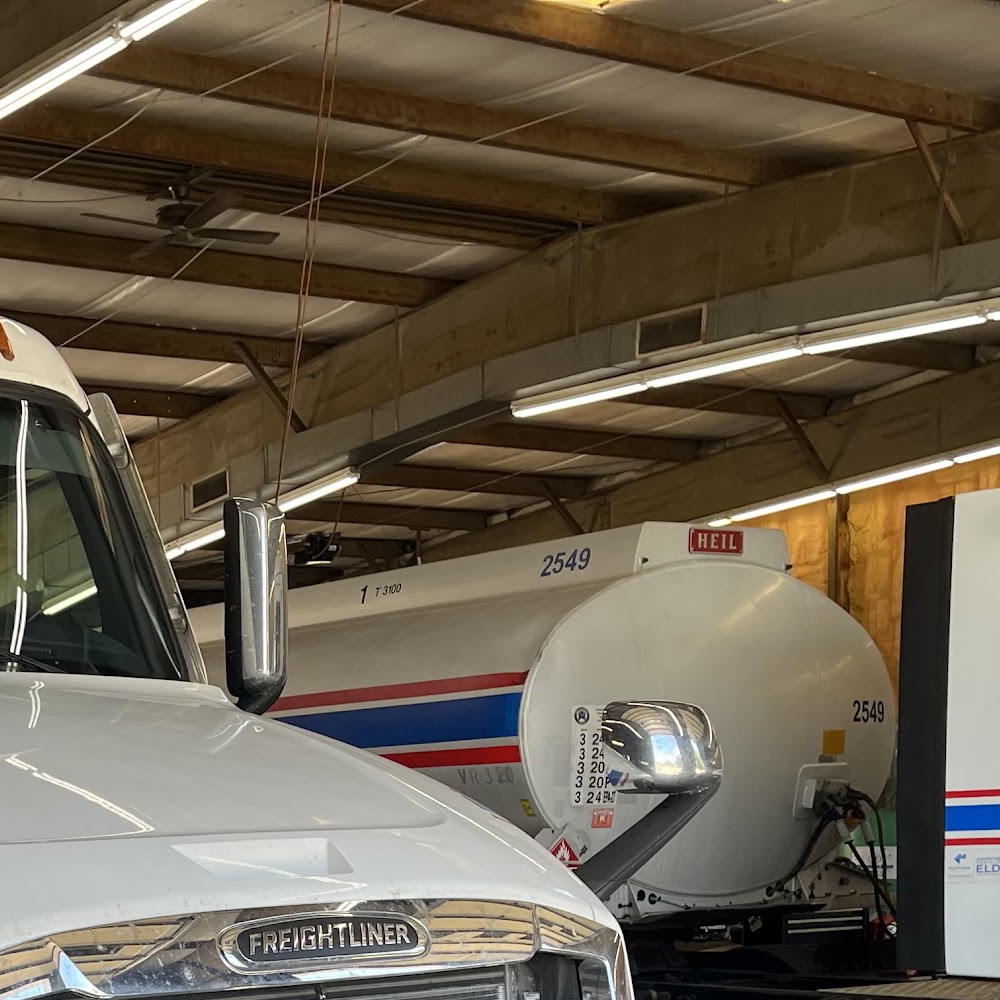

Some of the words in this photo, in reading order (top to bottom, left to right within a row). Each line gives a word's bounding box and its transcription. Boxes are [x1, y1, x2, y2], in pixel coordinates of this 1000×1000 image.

[697, 532, 737, 550] HEIL
[540, 547, 591, 577] 2549
[361, 585, 368, 604] 1
[382, 583, 402, 596] 3100
[852, 699, 885, 723] 2549
[976, 864, 1000, 874] ELD
[249, 922, 411, 956] FREIGHTLINER
